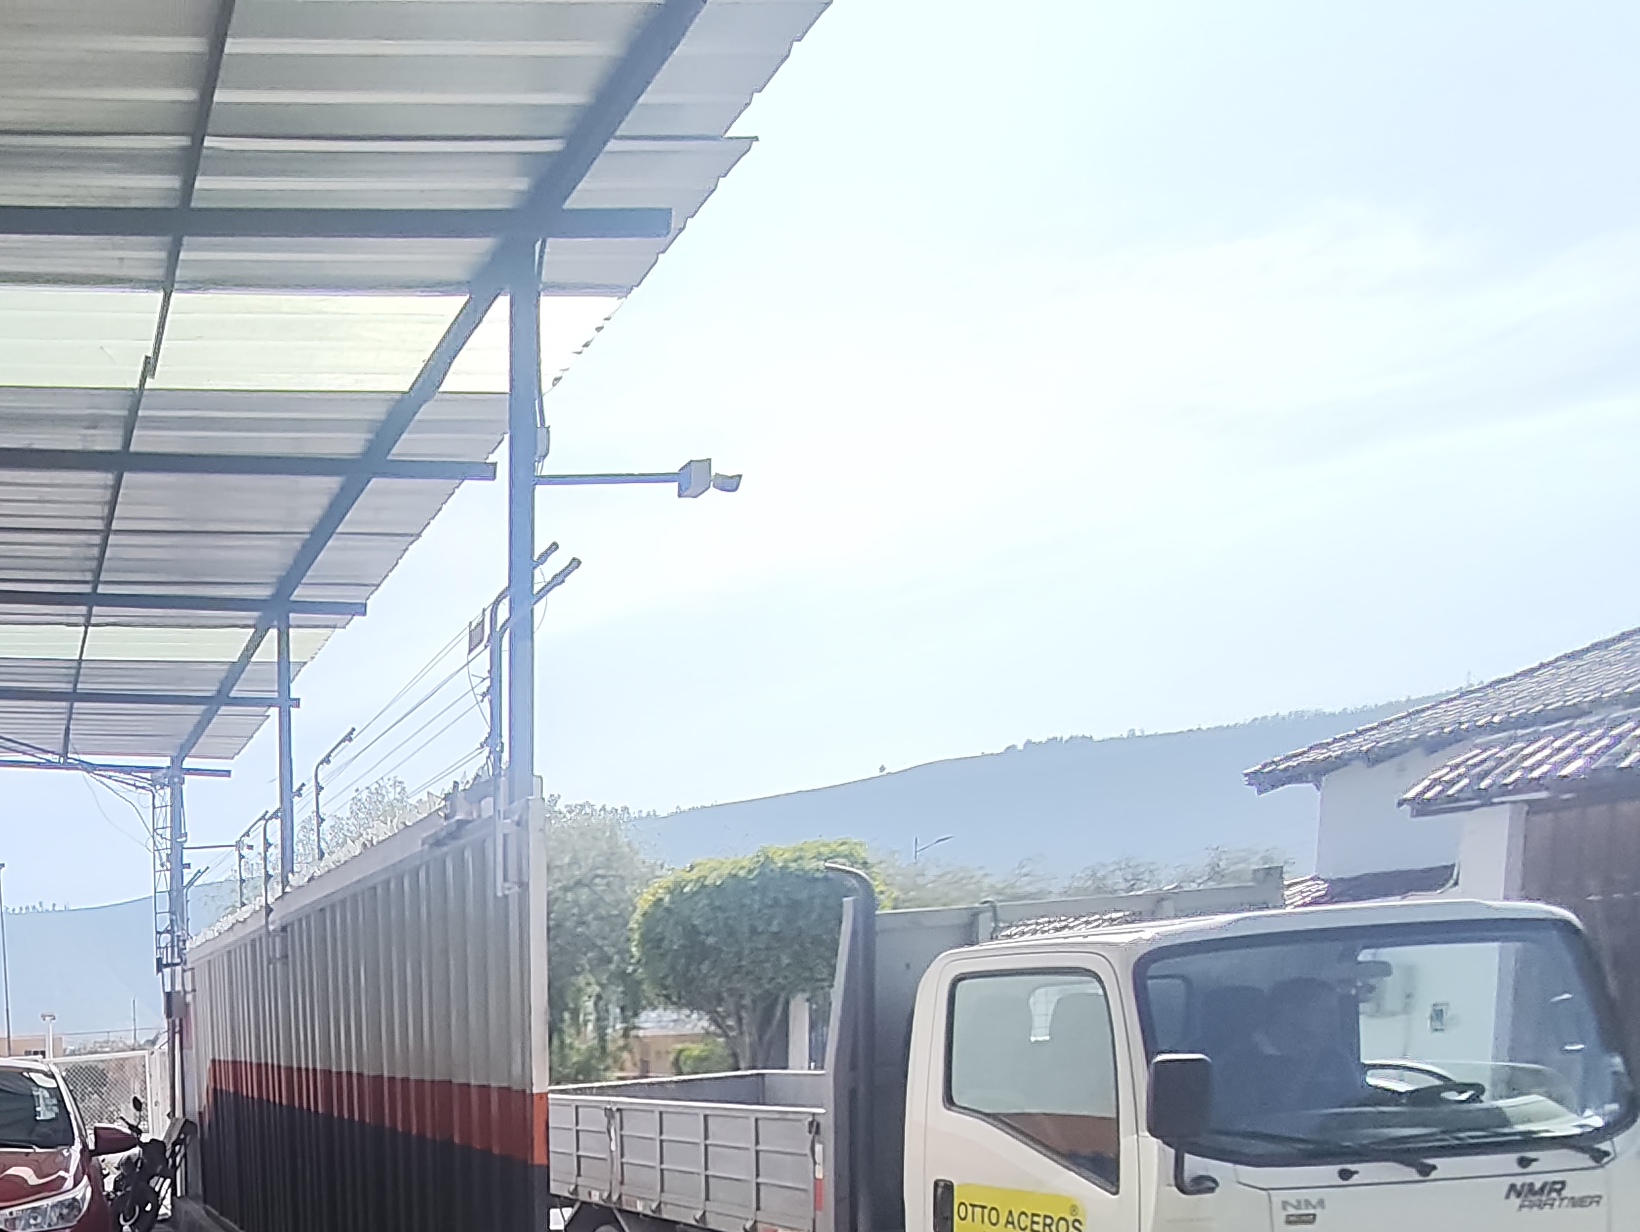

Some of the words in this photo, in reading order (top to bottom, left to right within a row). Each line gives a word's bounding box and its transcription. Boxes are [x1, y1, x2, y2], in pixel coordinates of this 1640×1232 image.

[1504, 1180, 1567, 1200] NMR
[1517, 1195, 1603, 1211] PARTNER
[957, 1202, 1000, 1227] OTTO
